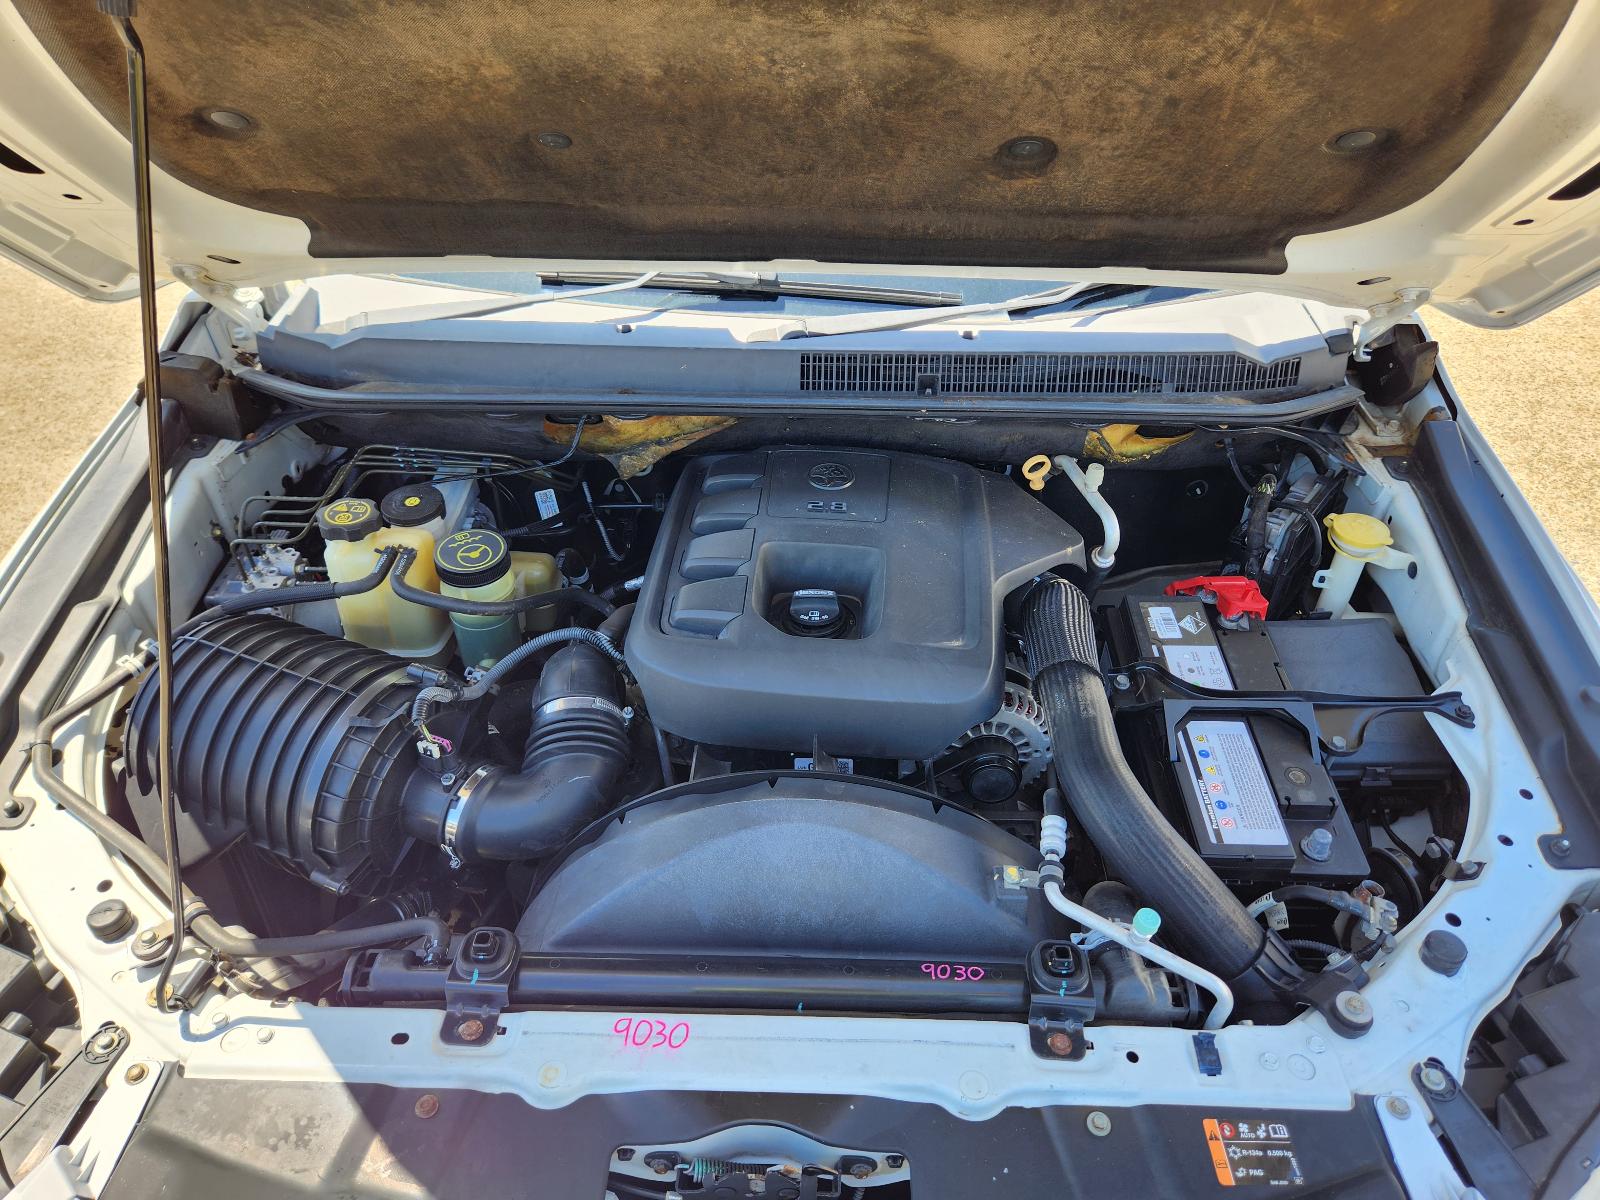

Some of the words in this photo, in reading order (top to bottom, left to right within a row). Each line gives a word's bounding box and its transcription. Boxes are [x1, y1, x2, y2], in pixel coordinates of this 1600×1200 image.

[807, 500, 847, 512] 2.8
[1197, 779, 1211, 805] BATTERY
[1206, 804, 1219, 830] Premium
[920, 963, 985, 981] 9030
[613, 1017, 690, 1049] 9030
